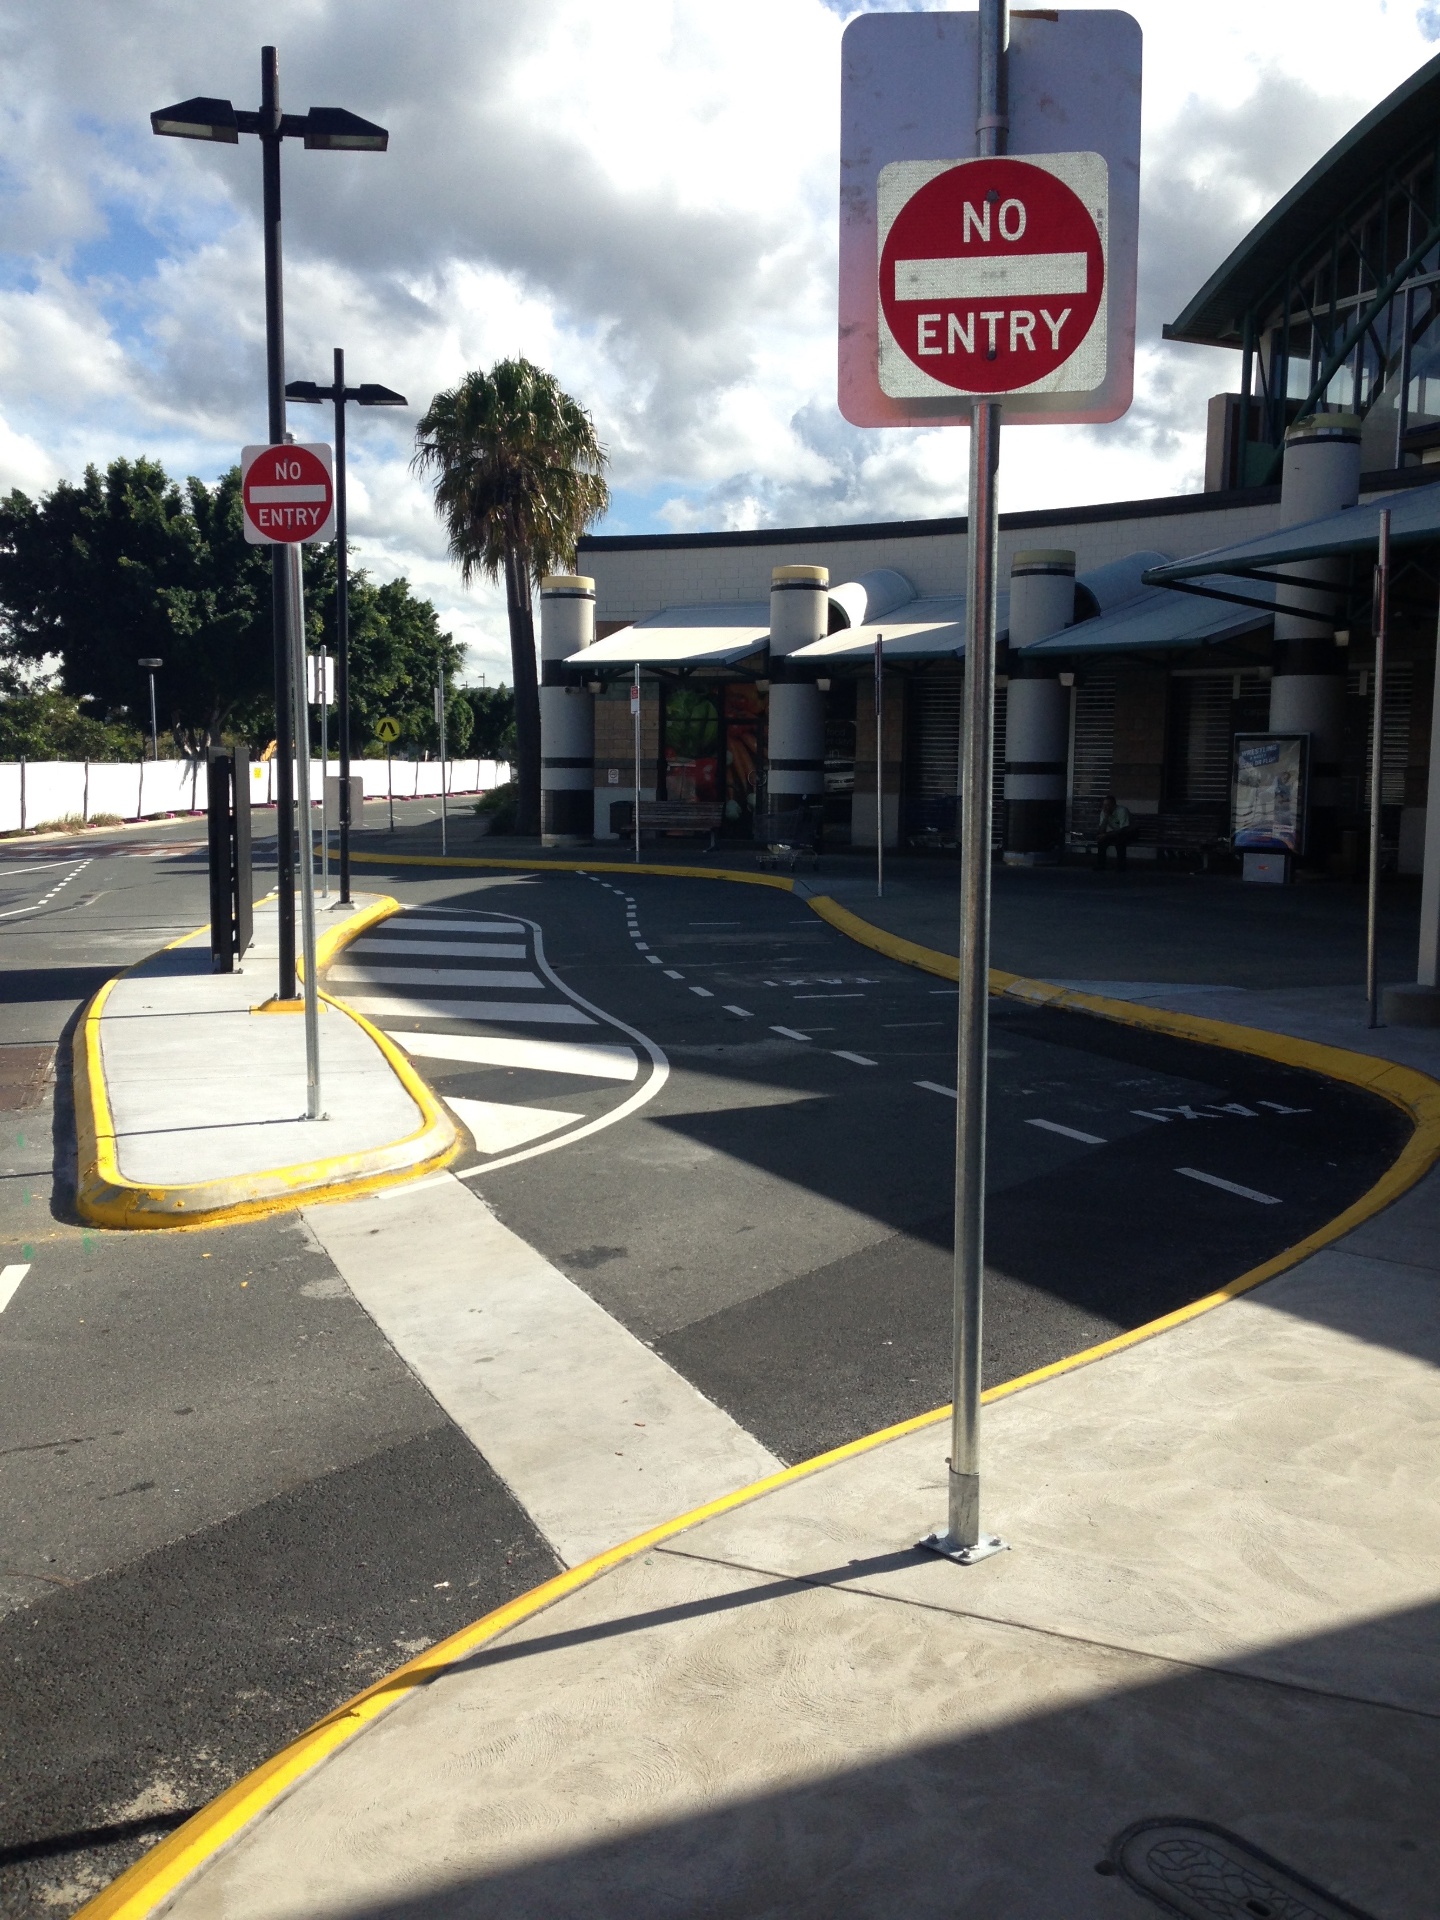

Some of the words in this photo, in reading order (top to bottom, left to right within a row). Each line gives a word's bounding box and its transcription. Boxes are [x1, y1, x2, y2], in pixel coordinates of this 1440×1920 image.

[963, 198, 1027, 243] NO
[917, 308, 1072, 356] ENTRY
[275, 461, 302, 480] NO
[258, 507, 321, 527] ENTRY
[762, 977, 881, 987] TAXI
[1129, 1100, 1313, 1122] TAXI
